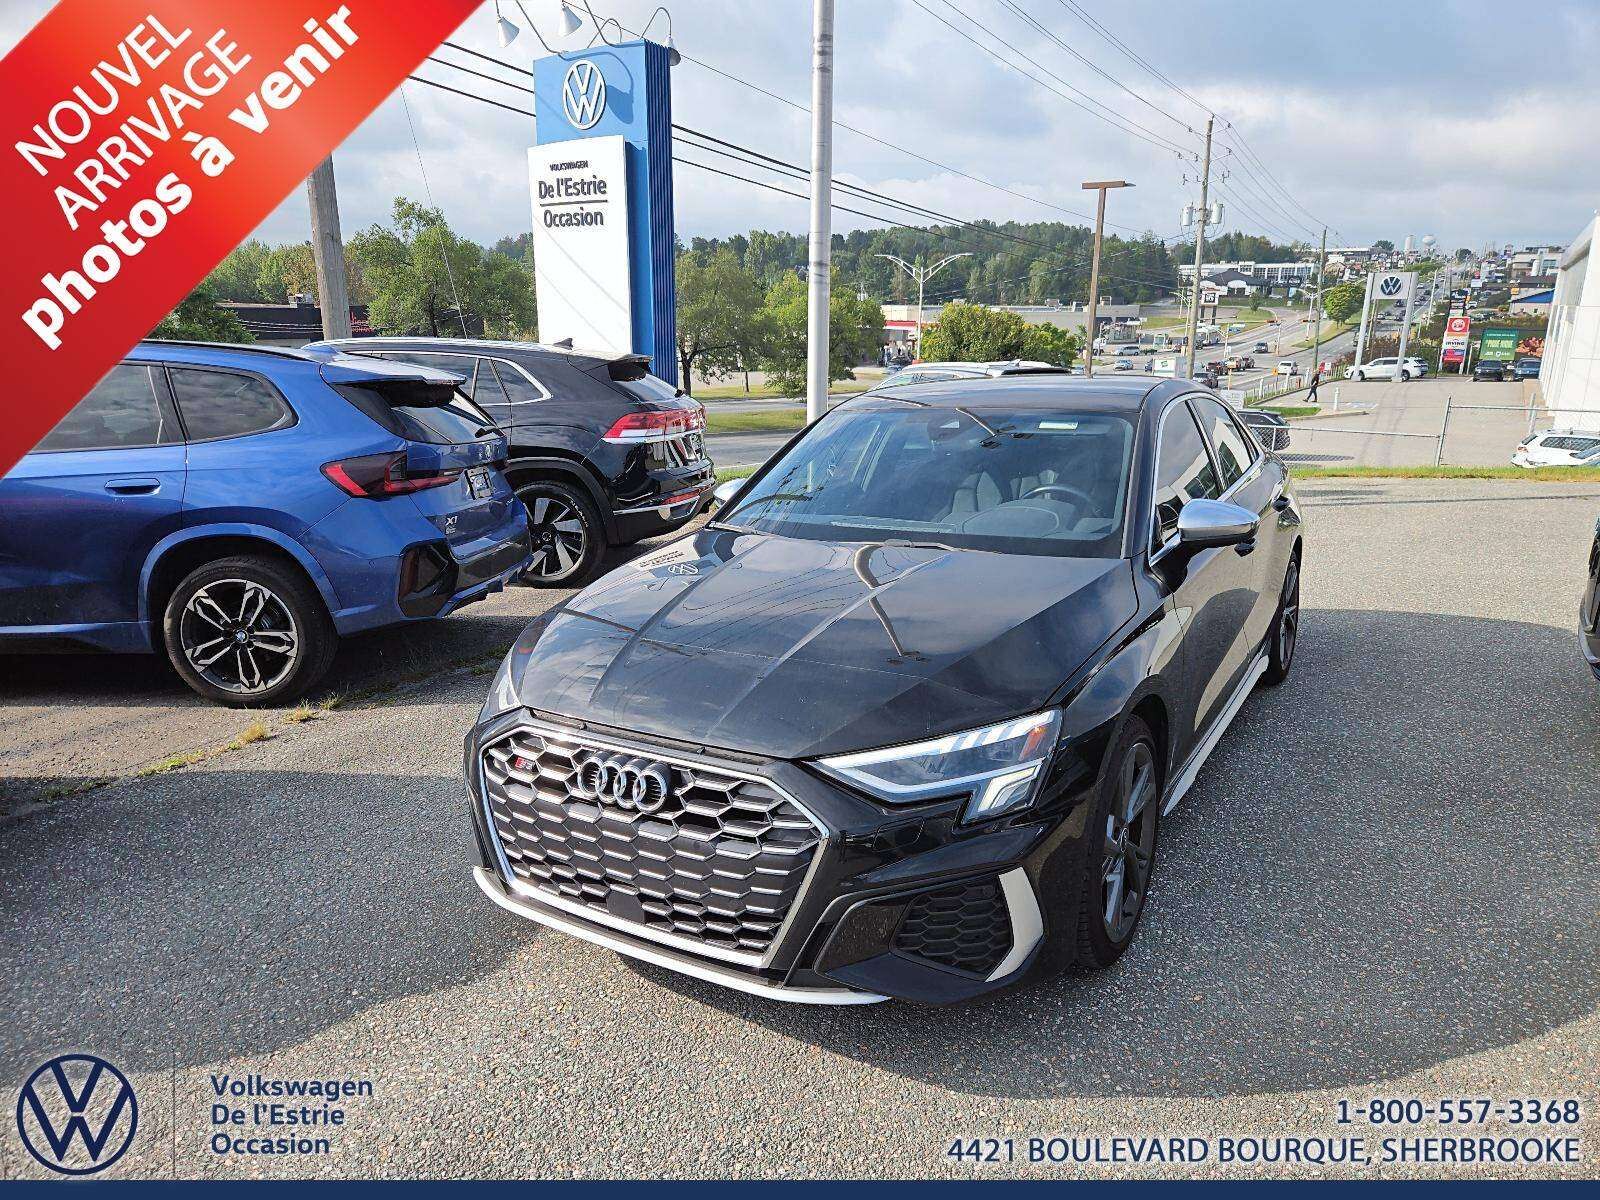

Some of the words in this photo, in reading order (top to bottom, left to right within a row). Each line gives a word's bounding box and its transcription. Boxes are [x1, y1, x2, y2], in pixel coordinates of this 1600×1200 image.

[549, 160, 589, 172] VOLKSWAGEN
[538, 180, 555, 199] De
[556, 175, 608, 197] l'Estrie
[543, 206, 604, 228] Occasion
